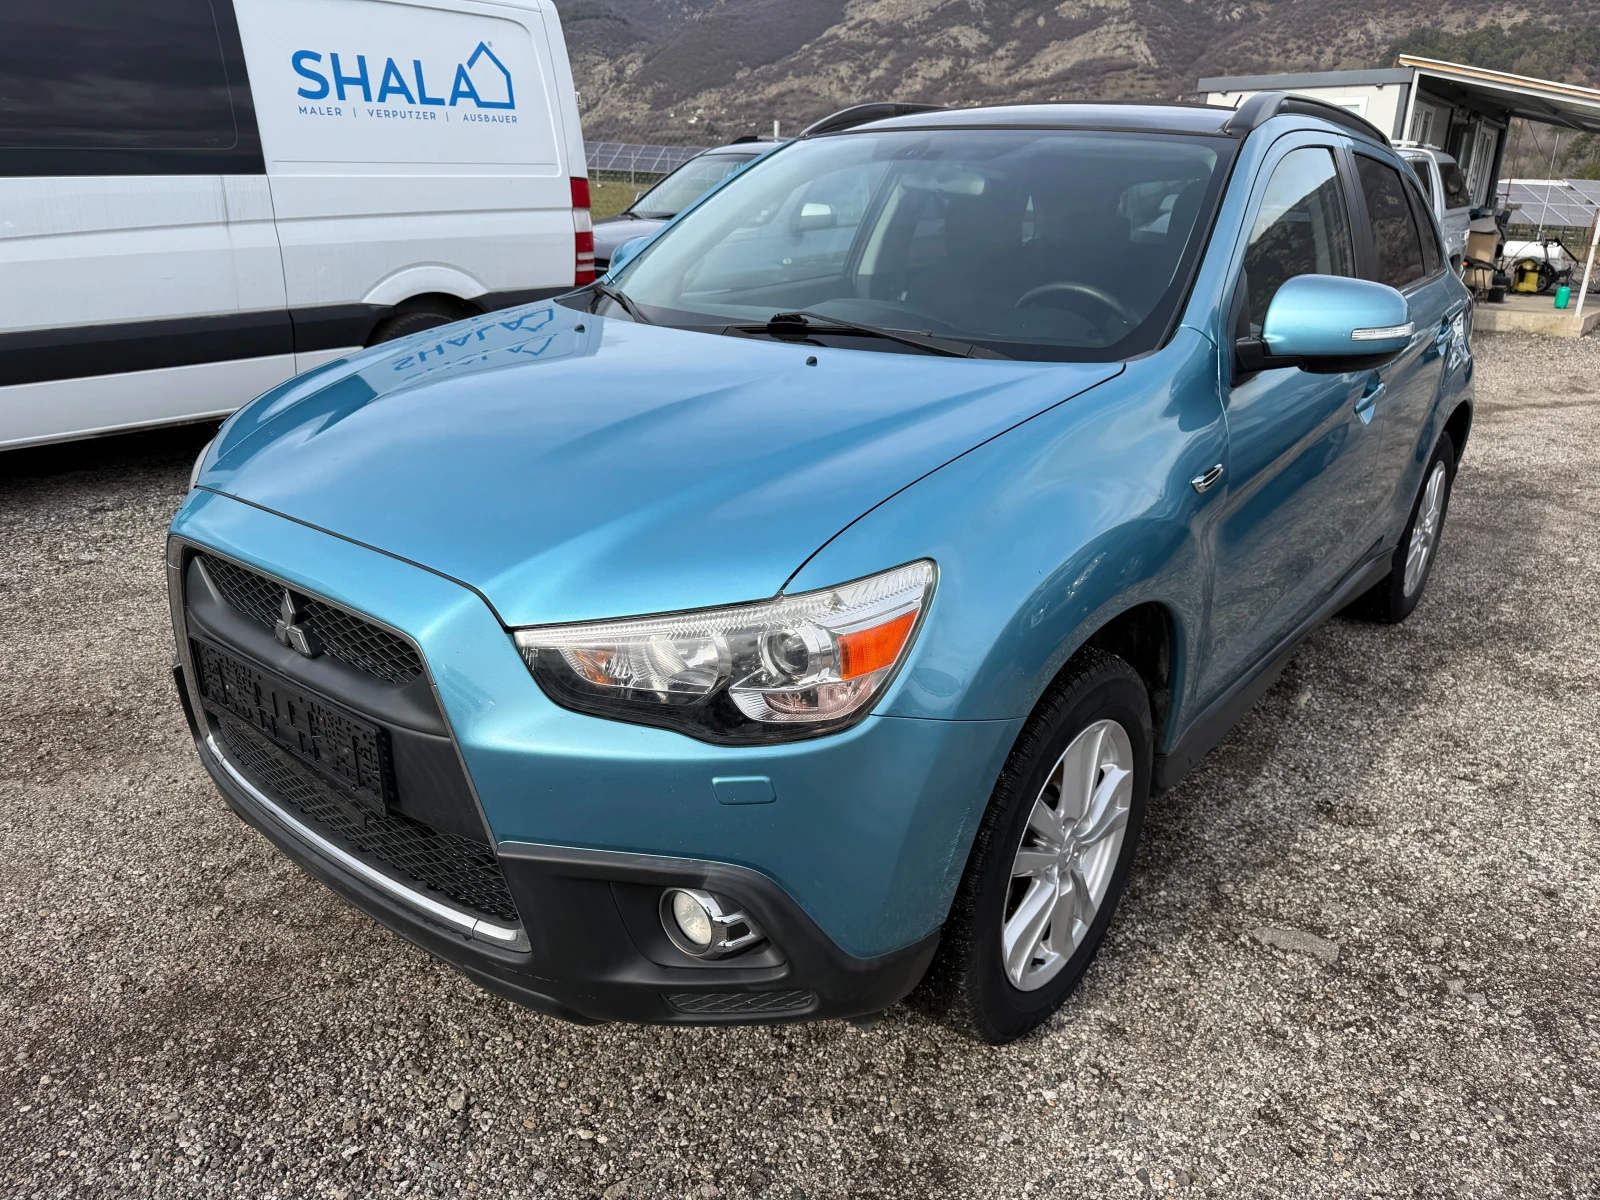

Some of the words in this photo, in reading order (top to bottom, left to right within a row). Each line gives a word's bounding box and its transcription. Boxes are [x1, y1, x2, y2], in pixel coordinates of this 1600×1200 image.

[291, 48, 486, 109] SHALA
[298, 105, 342, 117] MALER
[367, 108, 437, 121] VERPUTZER
[462, 113, 518, 124] AUSBAUER
